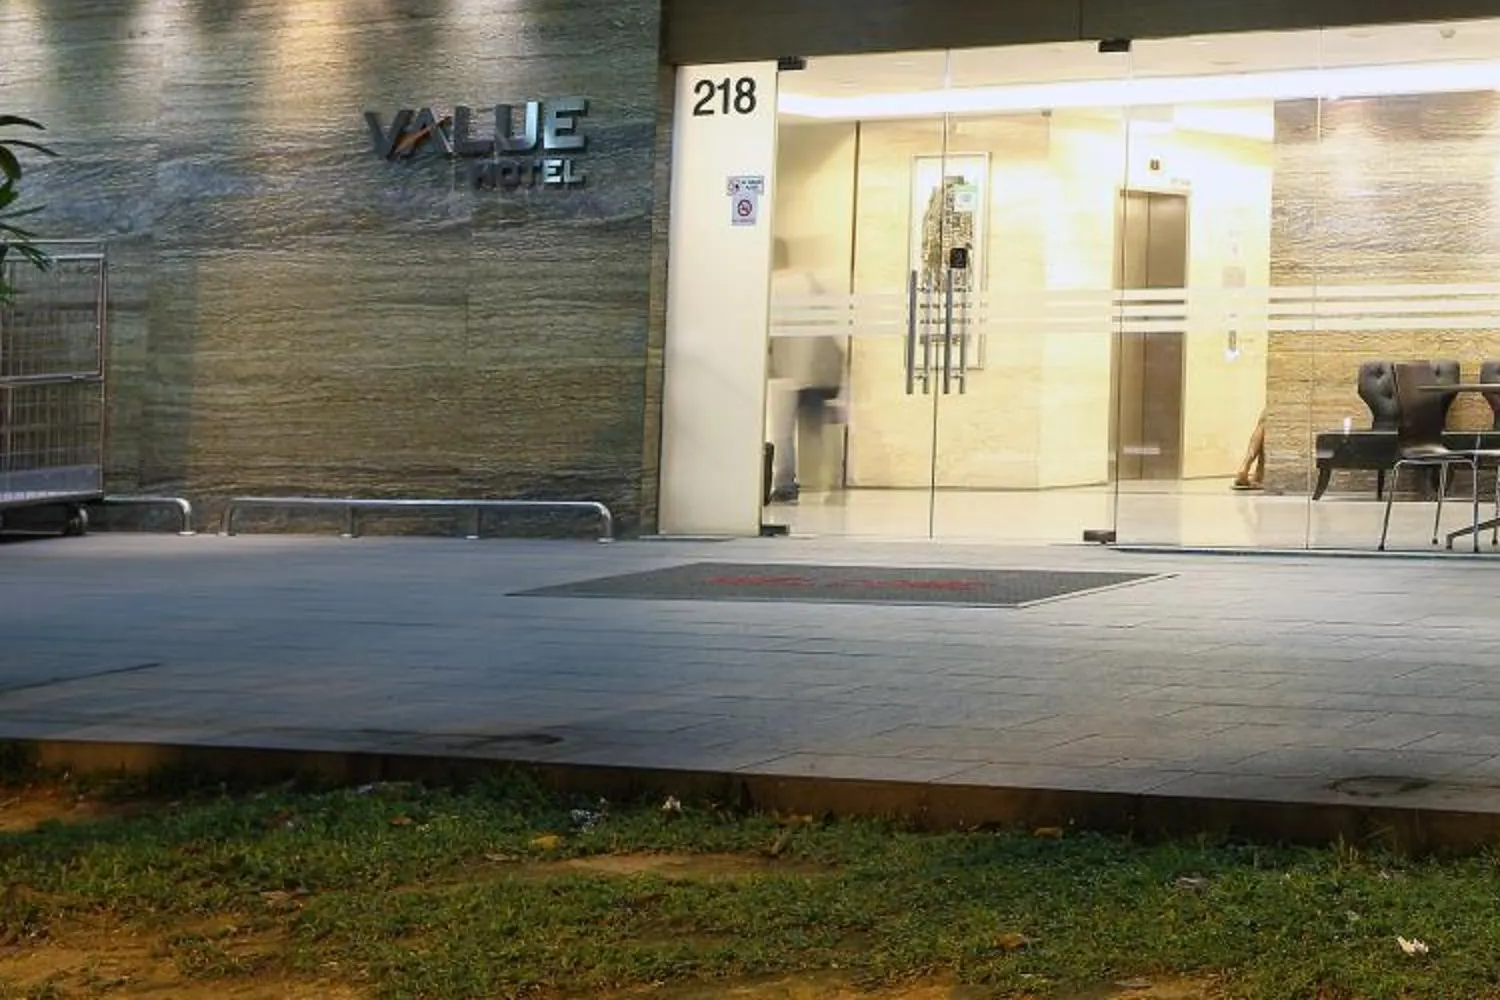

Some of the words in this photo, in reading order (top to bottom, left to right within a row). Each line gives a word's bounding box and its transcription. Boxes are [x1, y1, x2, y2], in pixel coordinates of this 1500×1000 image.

[692, 76, 757, 117] 218
[364, 97, 586, 158] VALUE
[472, 159, 584, 188] HOTEL
